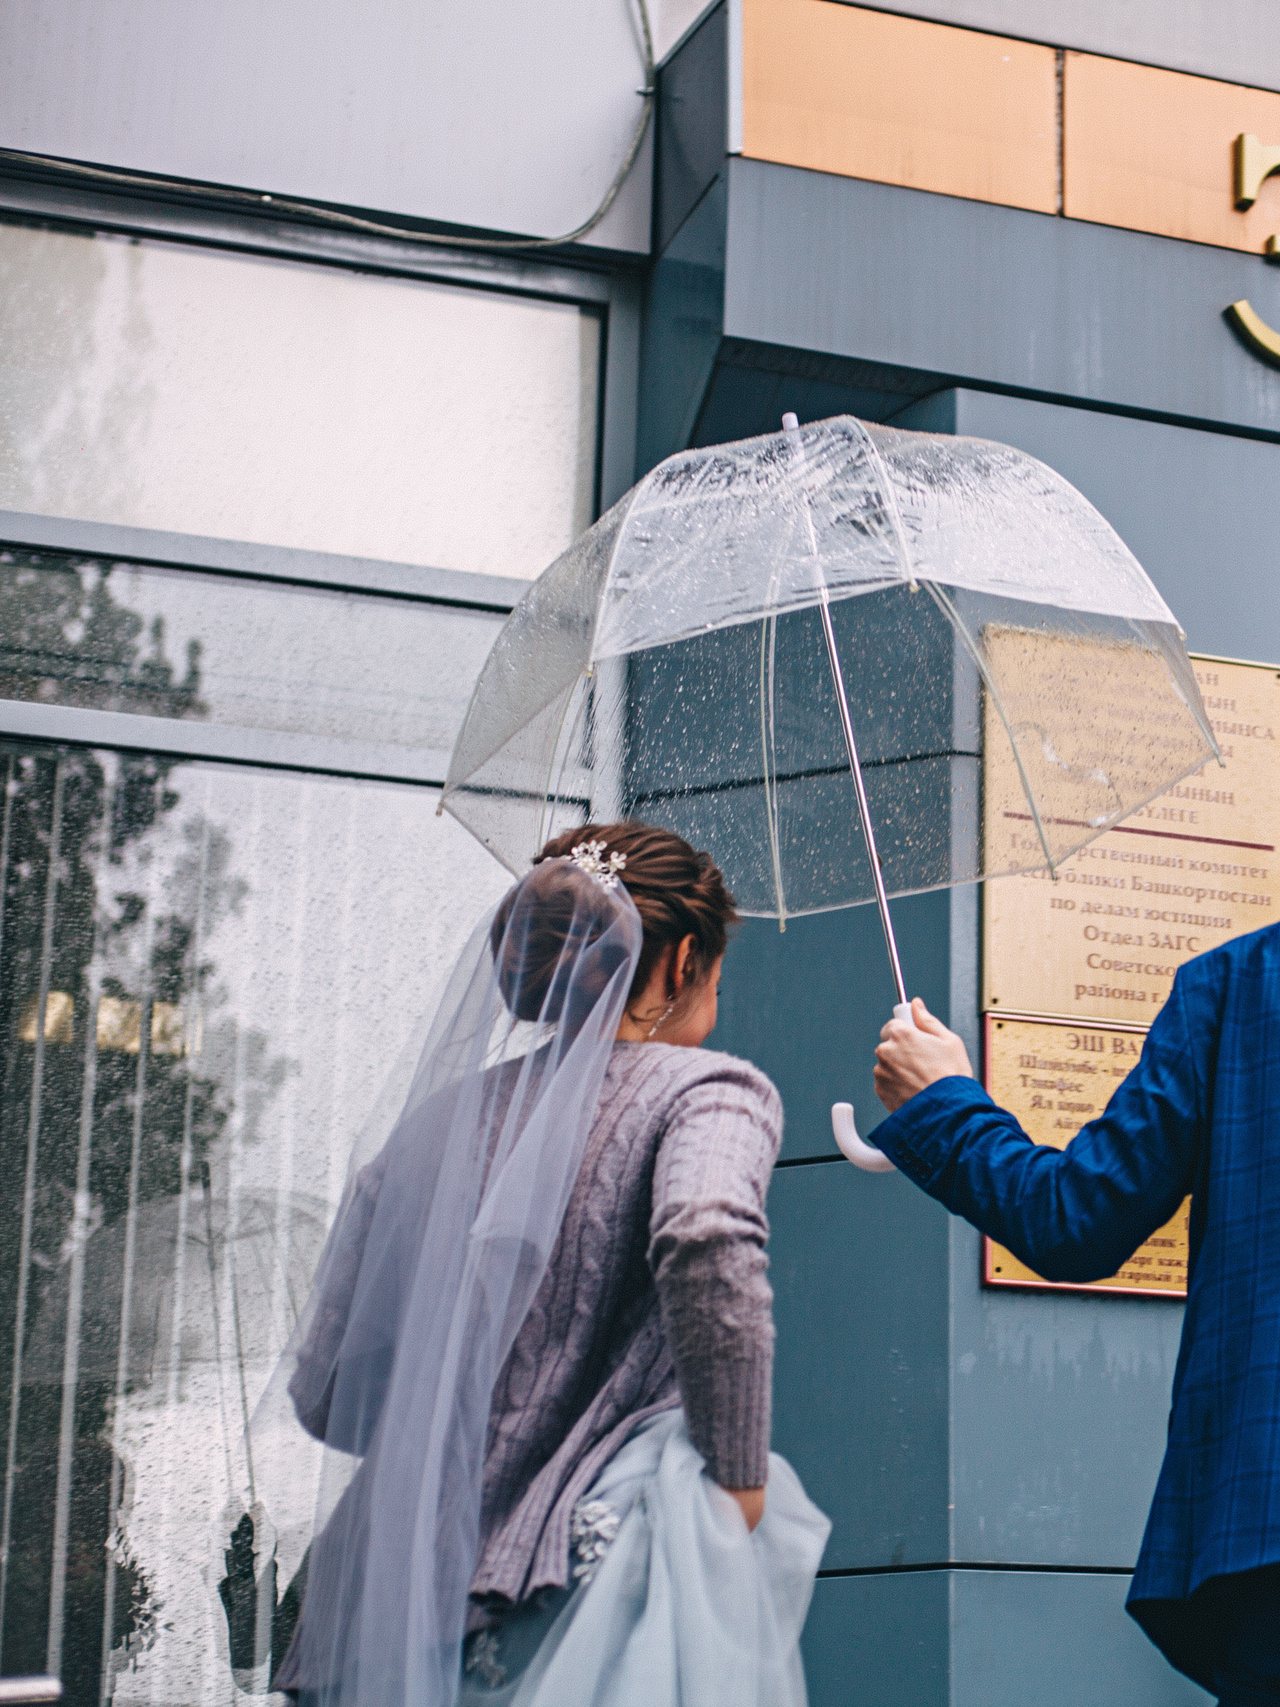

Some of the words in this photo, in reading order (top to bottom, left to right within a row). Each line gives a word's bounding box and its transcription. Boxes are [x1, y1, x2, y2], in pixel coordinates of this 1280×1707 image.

[1188, 859, 1269, 880] комитет
[1130, 875, 1272, 906] Башкортостан
[1050, 897, 1076, 911] по
[1080, 901, 1140, 919] делам
[1144, 908, 1232, 929] юстиции
[1083, 924, 1144, 947] Отдел
[1148, 931, 1201, 953] ЗАГС
[1086, 952, 1176, 978] Советско
[1073, 982, 1148, 1001] района
